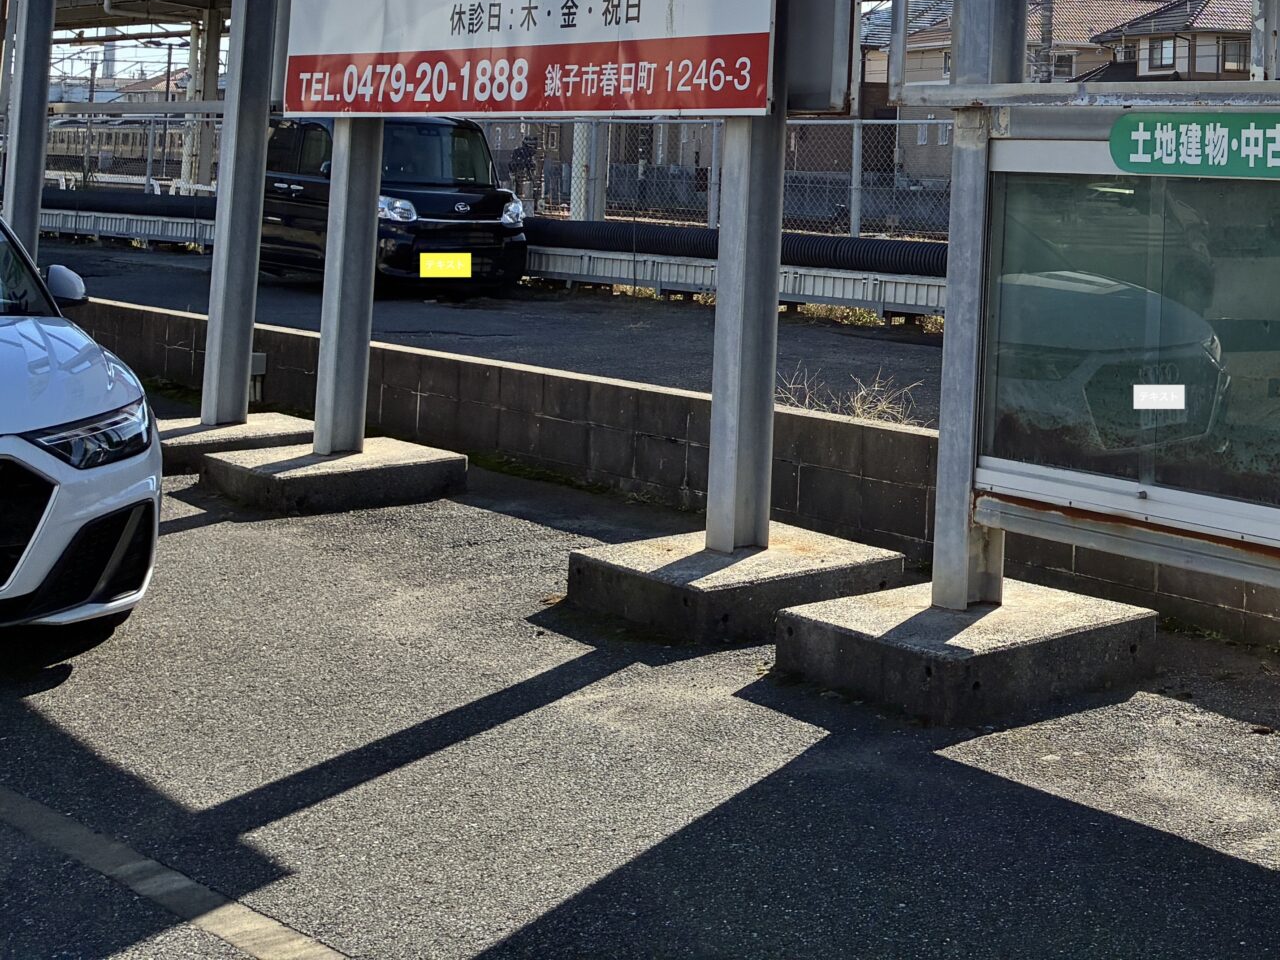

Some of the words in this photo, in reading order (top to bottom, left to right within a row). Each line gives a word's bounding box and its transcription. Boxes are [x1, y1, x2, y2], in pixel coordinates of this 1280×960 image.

[544, 61, 657, 98] 銚子市春日町
[665, 56, 751, 92] 1246-3
